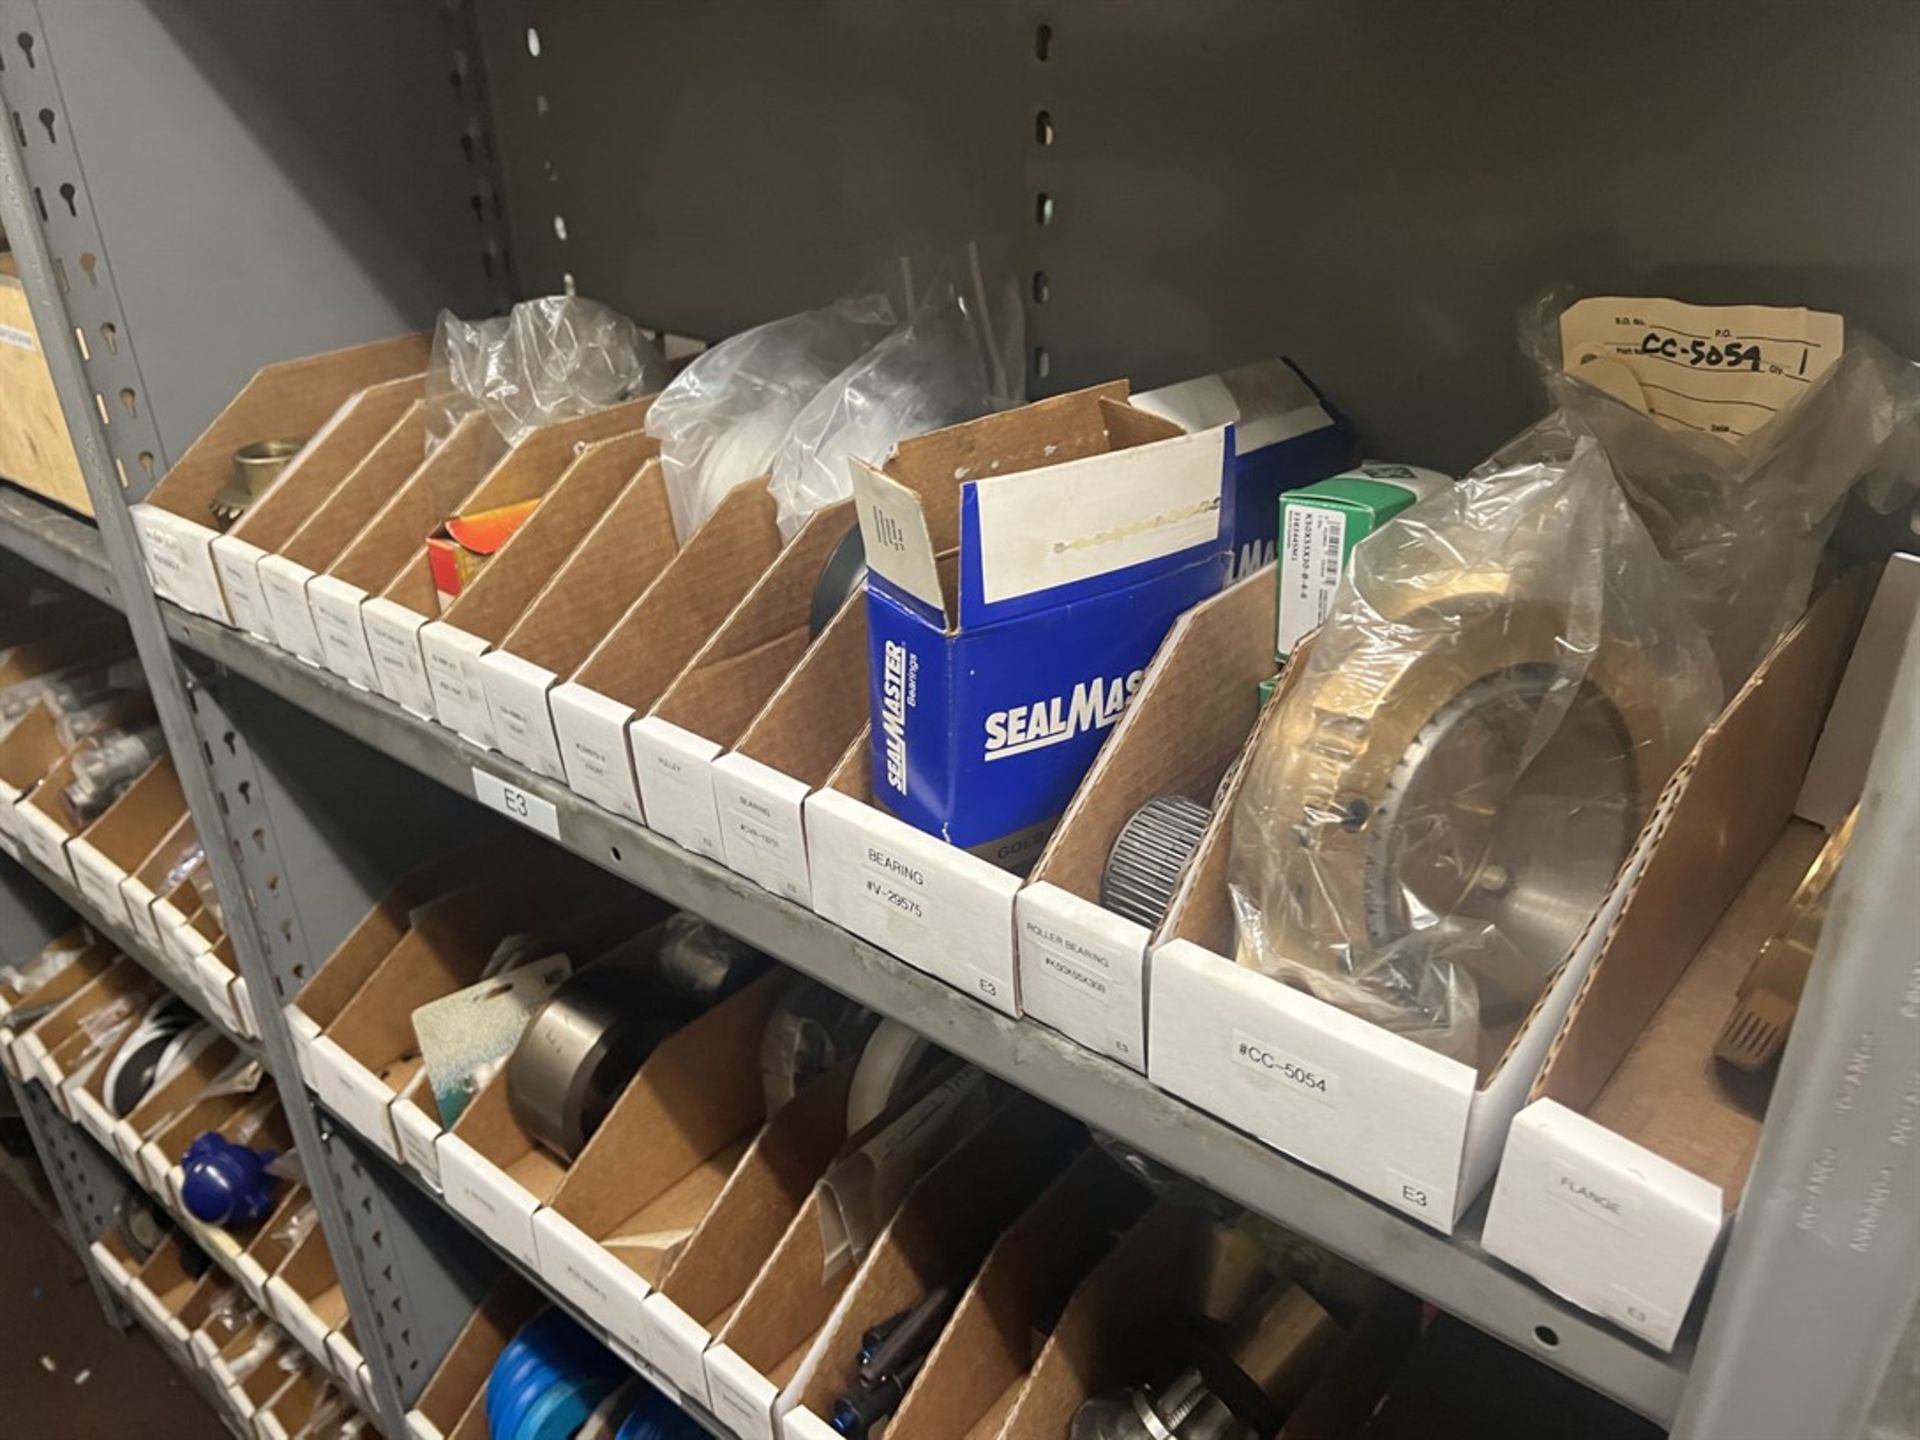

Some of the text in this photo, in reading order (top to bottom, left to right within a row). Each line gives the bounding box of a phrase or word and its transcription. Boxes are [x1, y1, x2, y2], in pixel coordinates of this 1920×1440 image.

[881, 640, 907, 796] SEALMASTER
[503, 787, 528, 817] E3
[868, 848, 924, 886] BEARING
[865, 880, 923, 918] #V-29575
[1026, 922, 1110, 968] ROLLER BEARING
[979, 977, 997, 997] E3
[1237, 1042, 1328, 1094] #CC-5054
[1402, 1184, 1428, 1208] E3
[1560, 1175, 1622, 1216] FLANGE
[1627, 1305, 1647, 1323] E3
